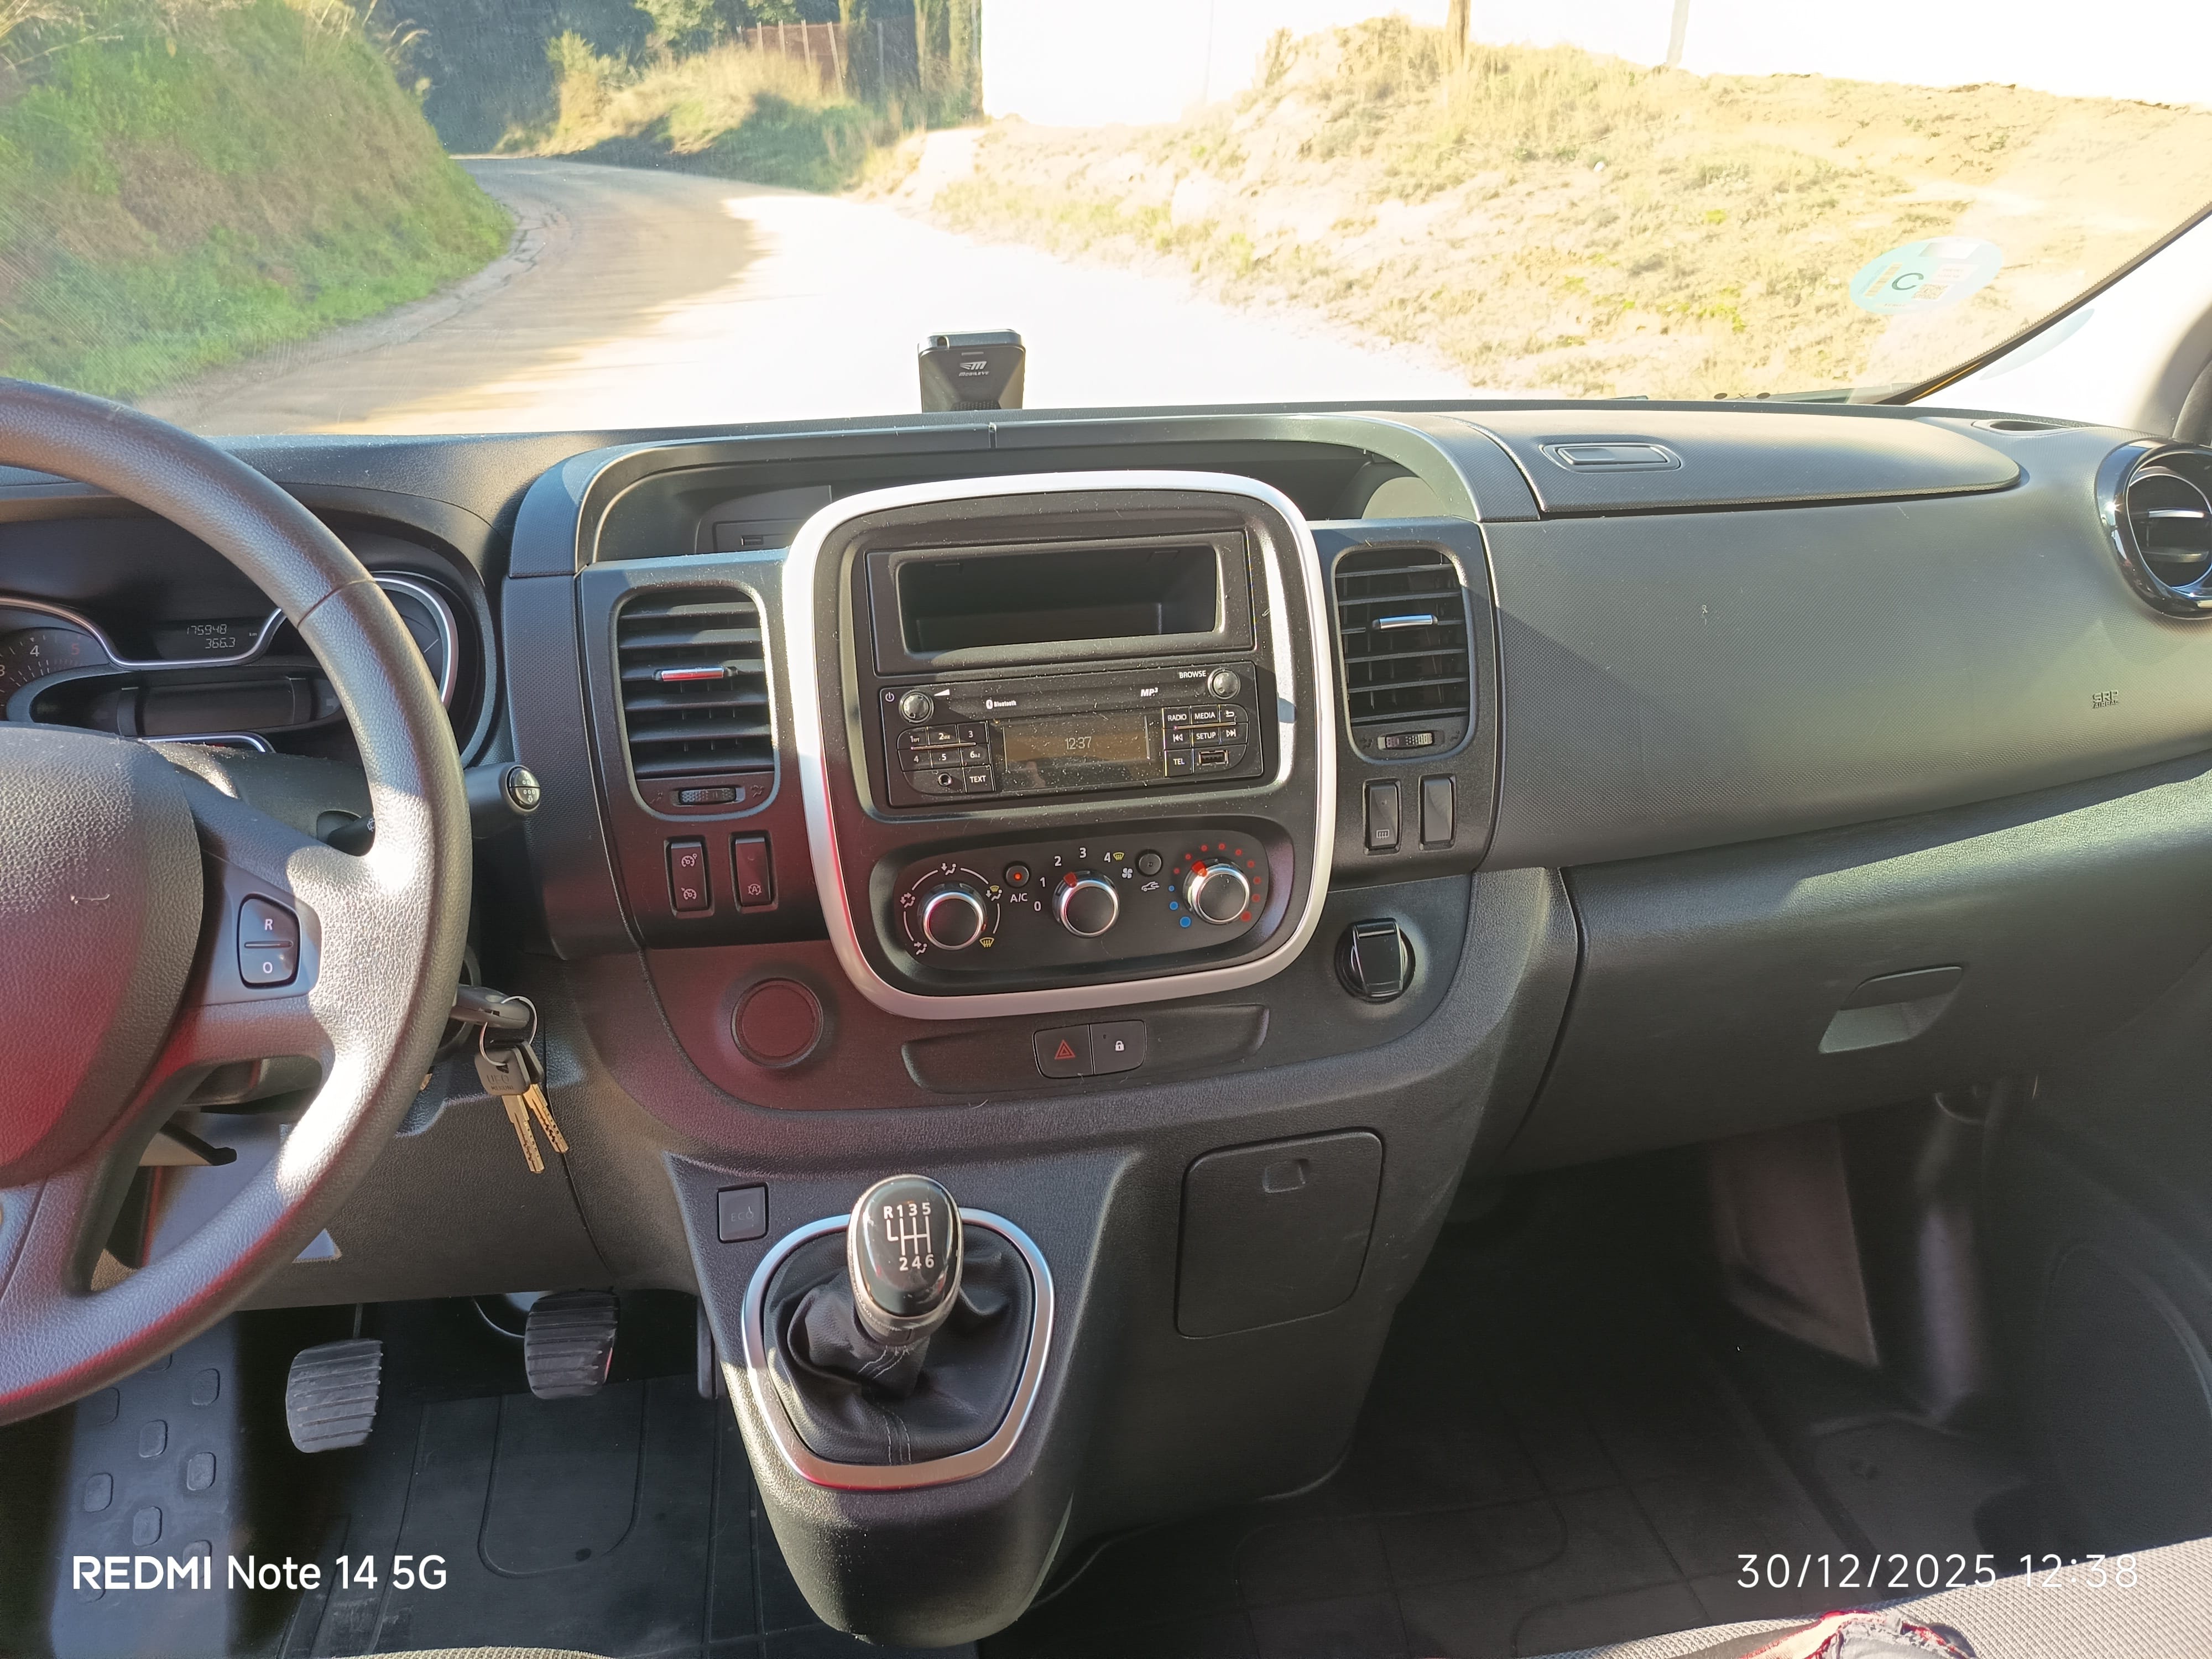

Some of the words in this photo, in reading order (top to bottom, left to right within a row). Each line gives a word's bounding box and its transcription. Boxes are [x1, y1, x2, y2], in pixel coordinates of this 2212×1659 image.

[186, 624, 227, 635] 175948
[205, 637, 236, 649] 366.3
[29, 645, 40, 657] 4
[1179, 670, 1206, 679] BROWSE
[1167, 713, 1187, 722] RADIO
[1194, 712, 1216, 720] MEDIA
[1196, 732, 1217, 740] SETUP
[1064, 736, 1092, 750] 12:37
[969, 775, 987, 784] TEXT
[1079, 847, 1087, 858] 3
[1104, 852, 1111, 863] 4
[1054, 855, 1062, 867] 2
[1039, 877, 1046, 888] 1
[1010, 893, 1028, 903] A/C
[1034, 901, 1042, 911] 0
[264, 919, 273, 930] R
